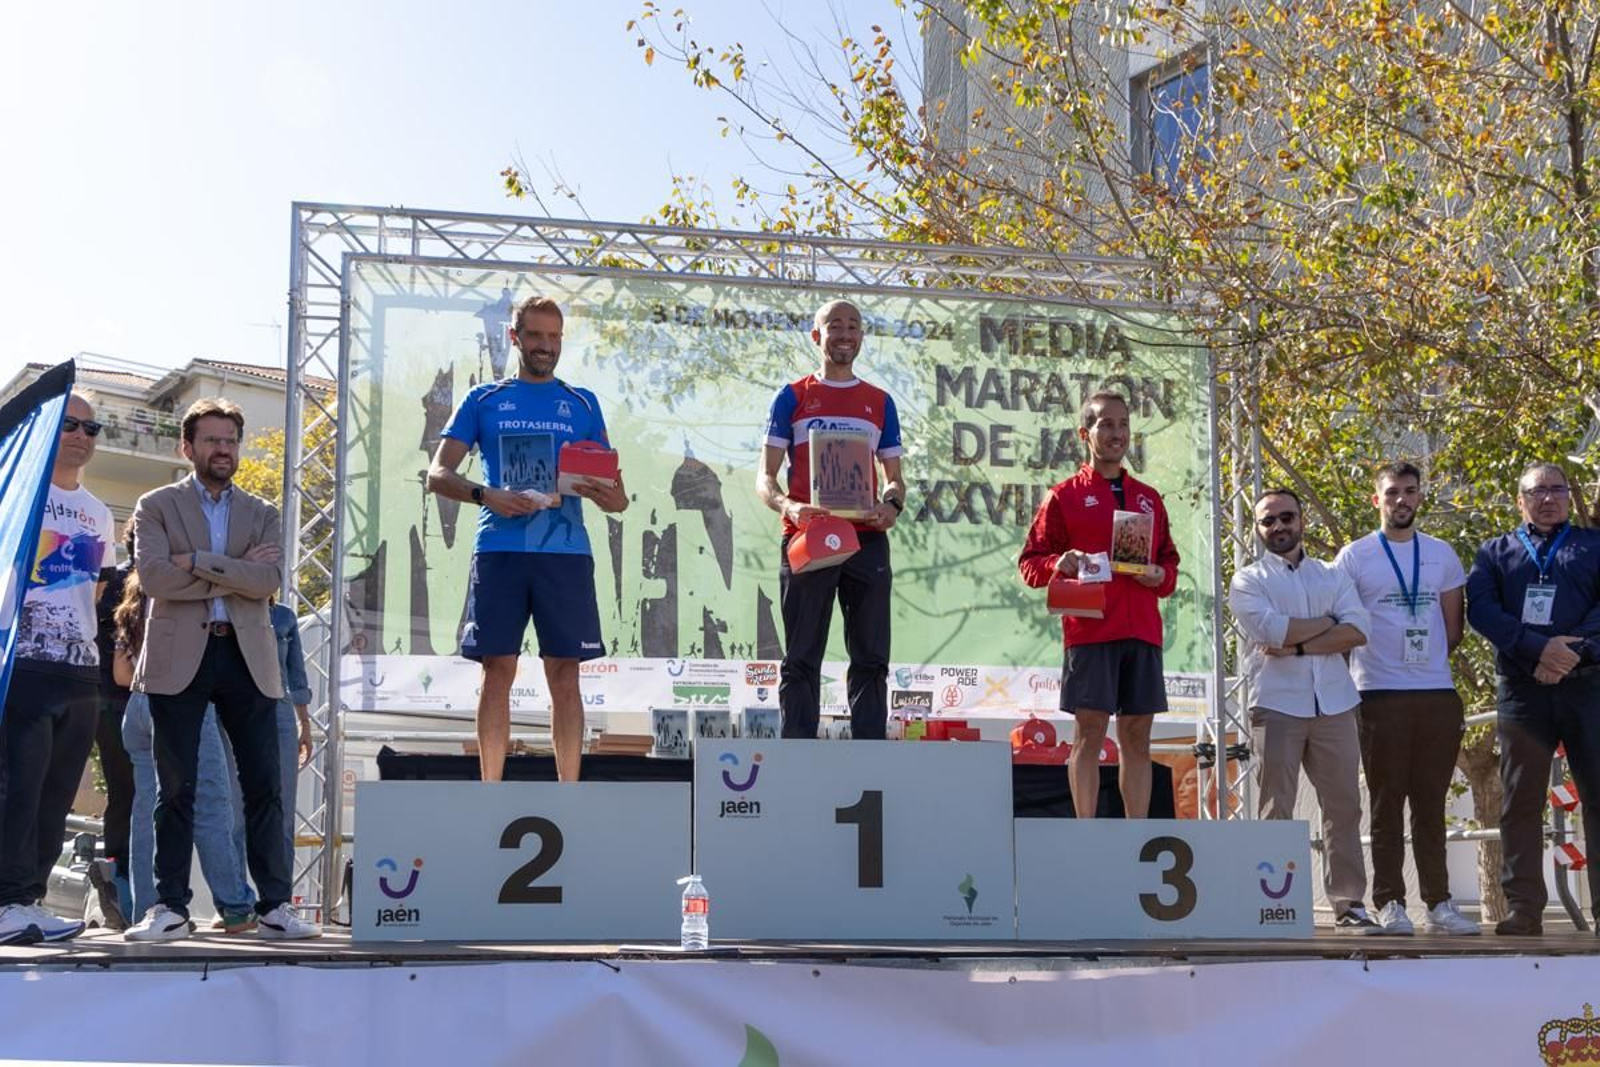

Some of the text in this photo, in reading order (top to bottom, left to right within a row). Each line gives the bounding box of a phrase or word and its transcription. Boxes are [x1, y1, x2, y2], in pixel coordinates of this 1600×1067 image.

[893, 317, 956, 341] 2024
[979, 315, 1131, 361] MEDIA
[498, 420, 573, 434] TROTASIERRA
[953, 421, 1145, 474] DE JAN
[940, 668, 978, 677] POWER
[956, 677, 977, 687] ADE
[498, 816, 564, 904] 2
[835, 790, 884, 888] 1
[1139, 836, 1197, 921] 3
